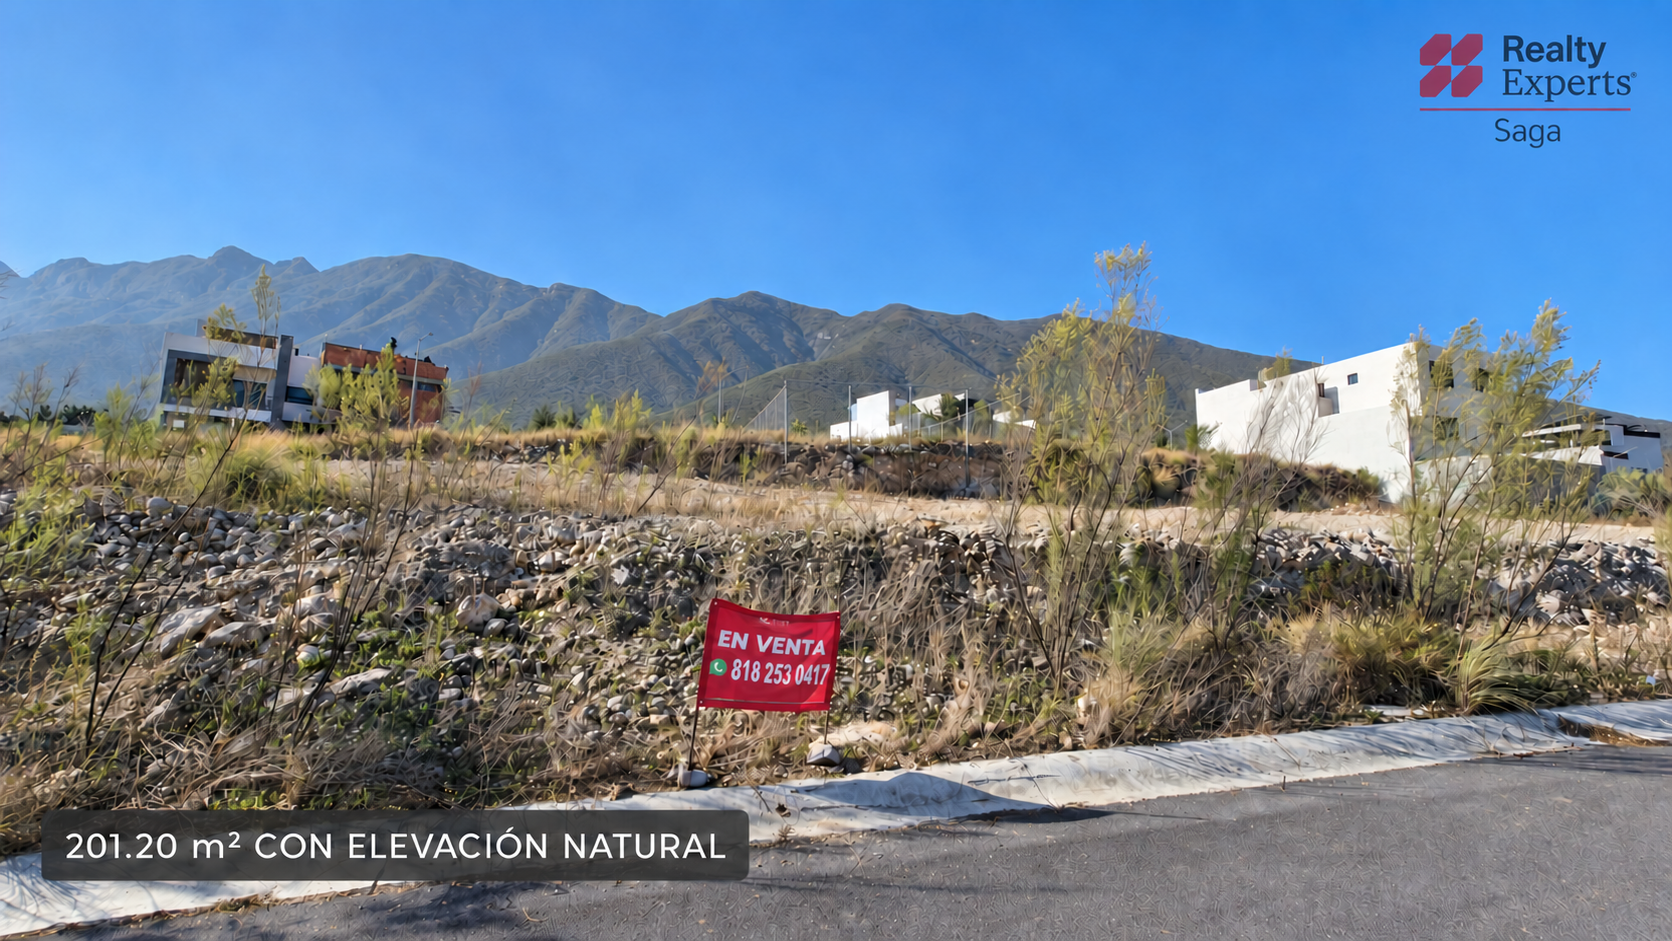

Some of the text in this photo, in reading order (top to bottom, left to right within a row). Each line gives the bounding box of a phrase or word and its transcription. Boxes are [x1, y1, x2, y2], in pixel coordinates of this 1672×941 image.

[717, 629, 826, 656] EN VENTA
[731, 658, 830, 686] 818 253 0417
